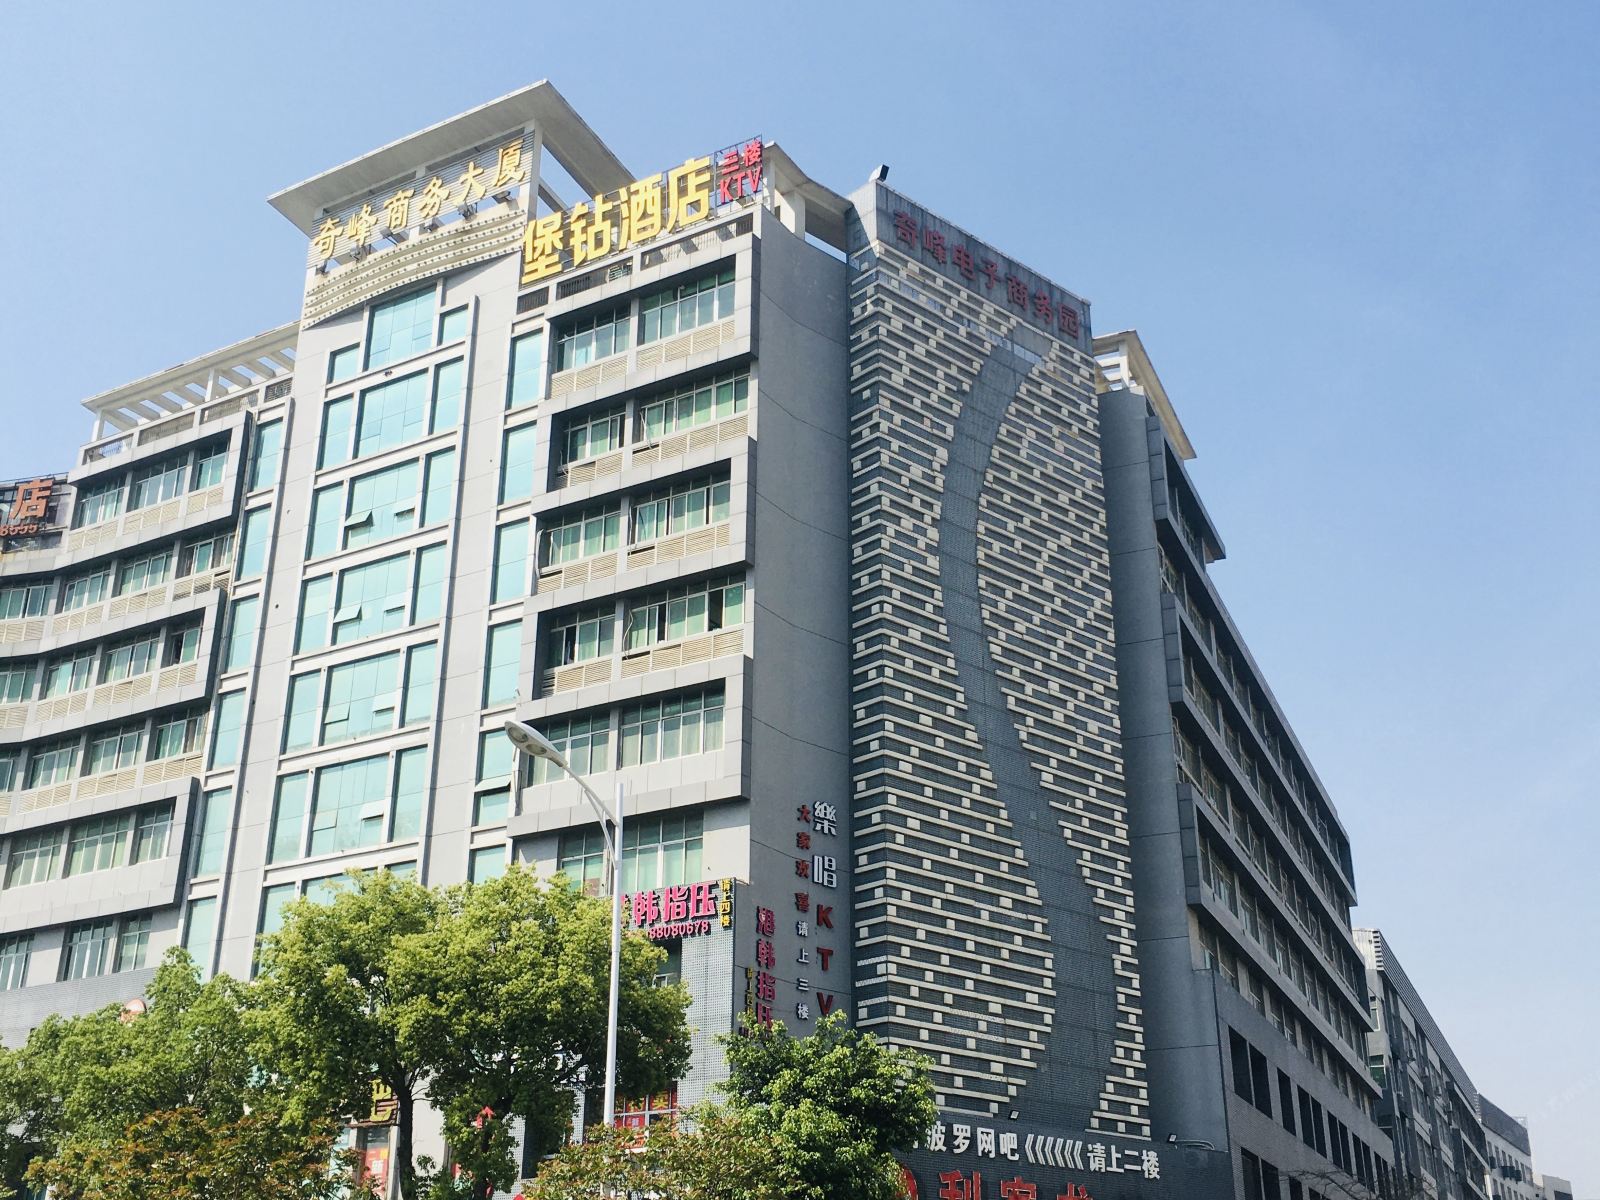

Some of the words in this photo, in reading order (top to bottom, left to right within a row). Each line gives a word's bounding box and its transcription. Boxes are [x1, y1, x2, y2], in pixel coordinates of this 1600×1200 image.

[719, 166, 762, 205] KTV
[721, 140, 762, 175] 三楼
[314, 138, 525, 260] 奇峰商务大厦
[522, 156, 711, 284] 堡钻酒店
[893, 209, 1079, 339] 奇峰电子商务园
[1086, 1143, 1161, 1180] 请上二楼
